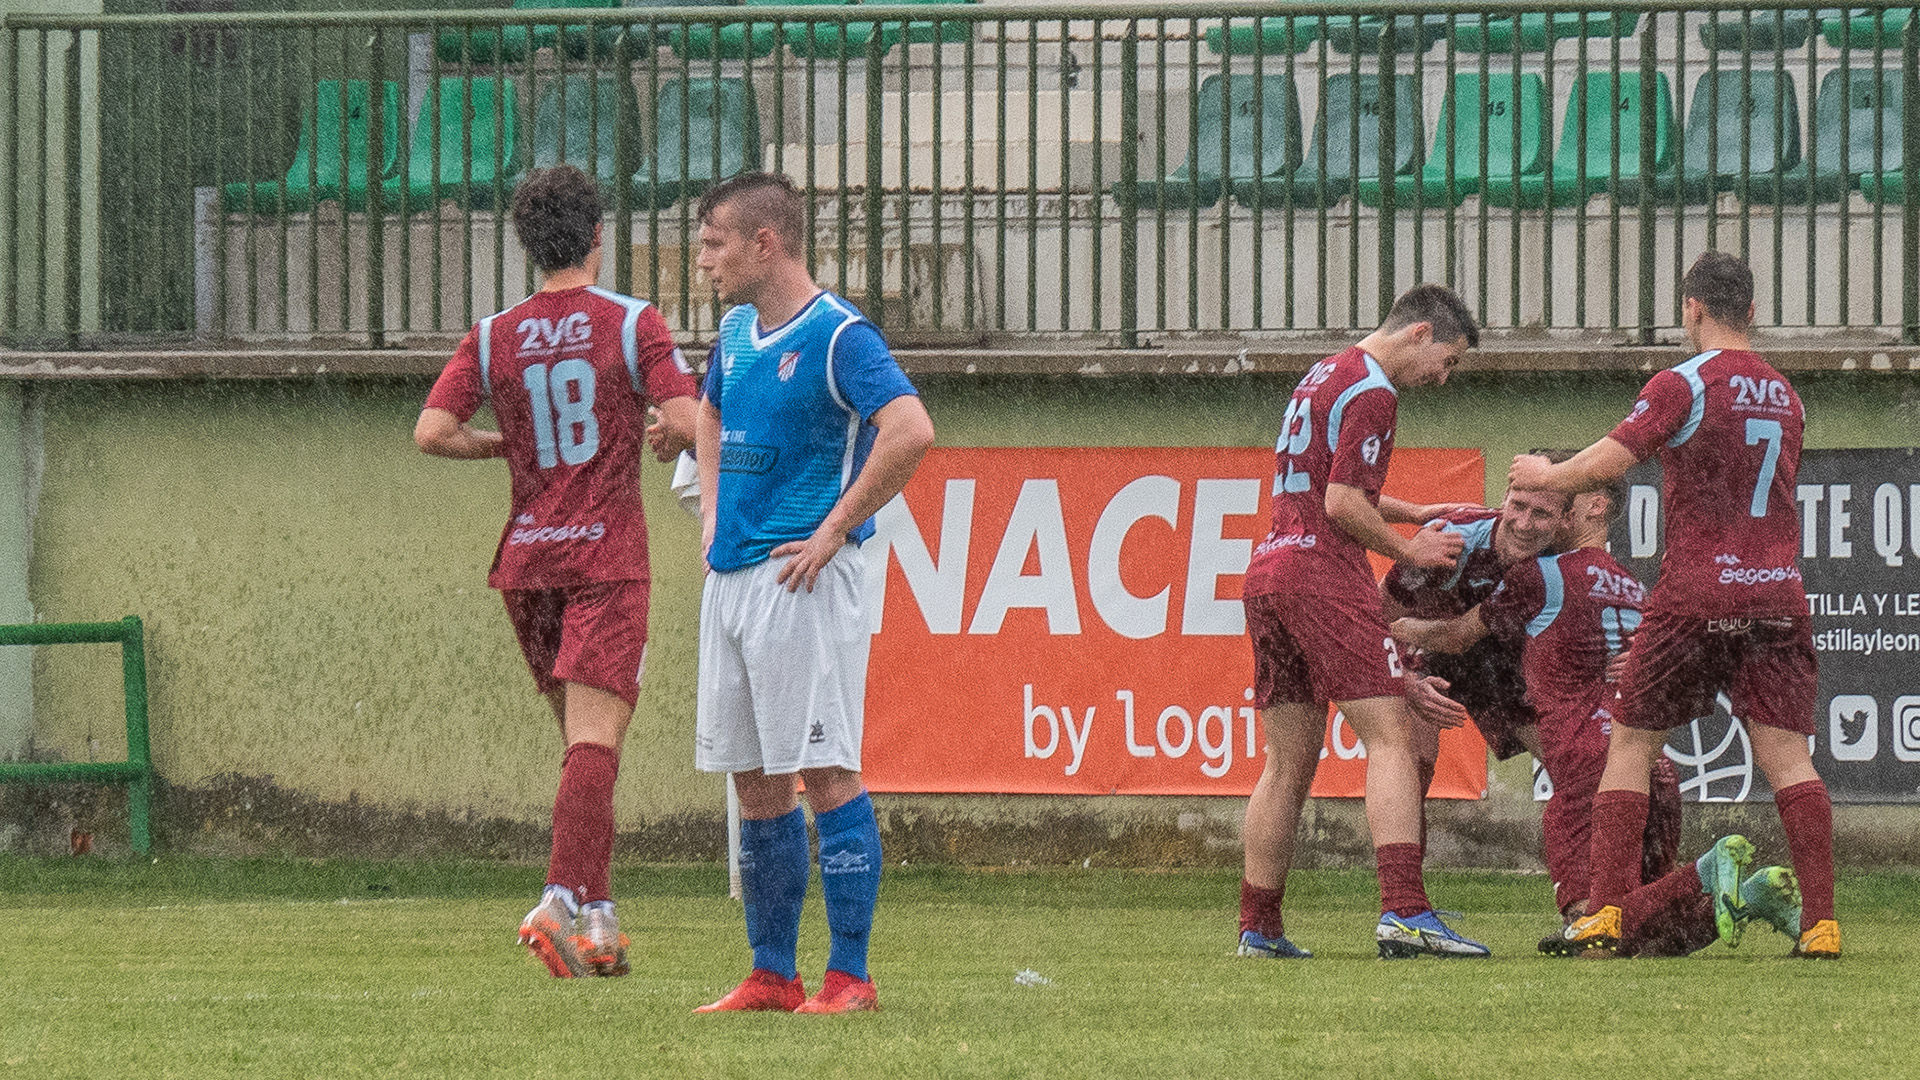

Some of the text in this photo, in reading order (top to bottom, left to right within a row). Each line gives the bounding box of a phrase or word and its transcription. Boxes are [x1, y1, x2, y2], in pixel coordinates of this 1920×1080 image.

[1487, 101, 1506, 117] 15
[516, 311, 593, 347] 2VG
[523, 358, 600, 469] 18
[1729, 375, 1790, 407] 2VG
[1745, 418, 1783, 518] 7
[870, 475, 1262, 639] NACE
[1872, 593, 1889, 616] Y
[1894, 593, 1920, 616] LE
[1024, 684, 1367, 778] by logia
